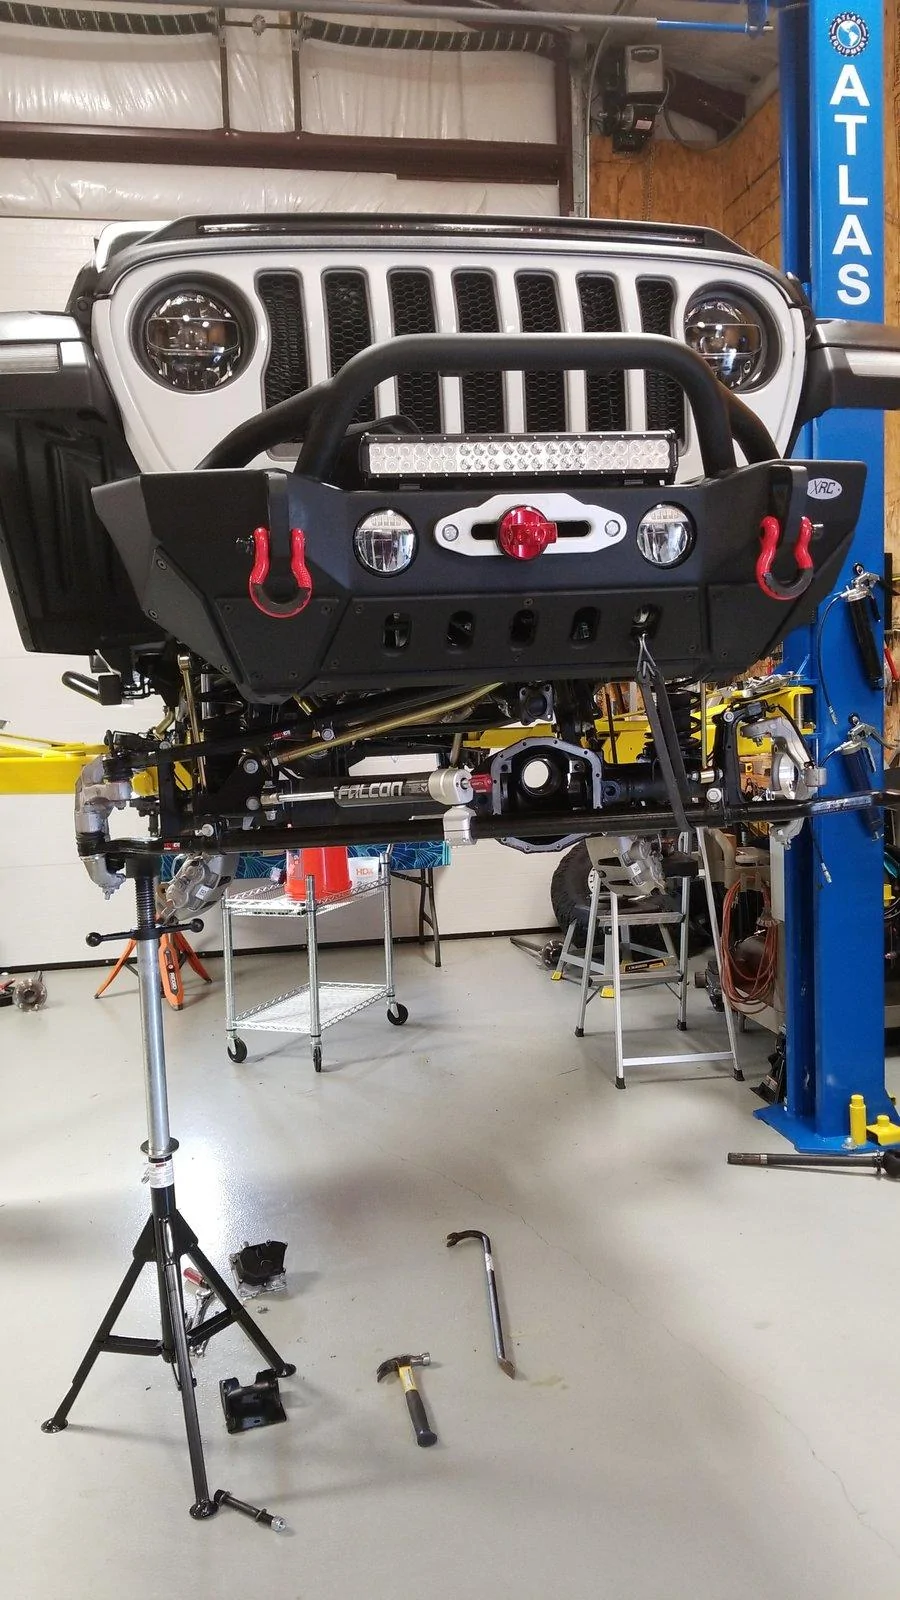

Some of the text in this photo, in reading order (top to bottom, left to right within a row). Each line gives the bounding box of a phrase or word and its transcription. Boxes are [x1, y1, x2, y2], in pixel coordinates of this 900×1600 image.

[829, 64, 873, 306] ATLAS
[810, 480, 836, 494] XRC
[338, 781, 404, 800] FALCON
